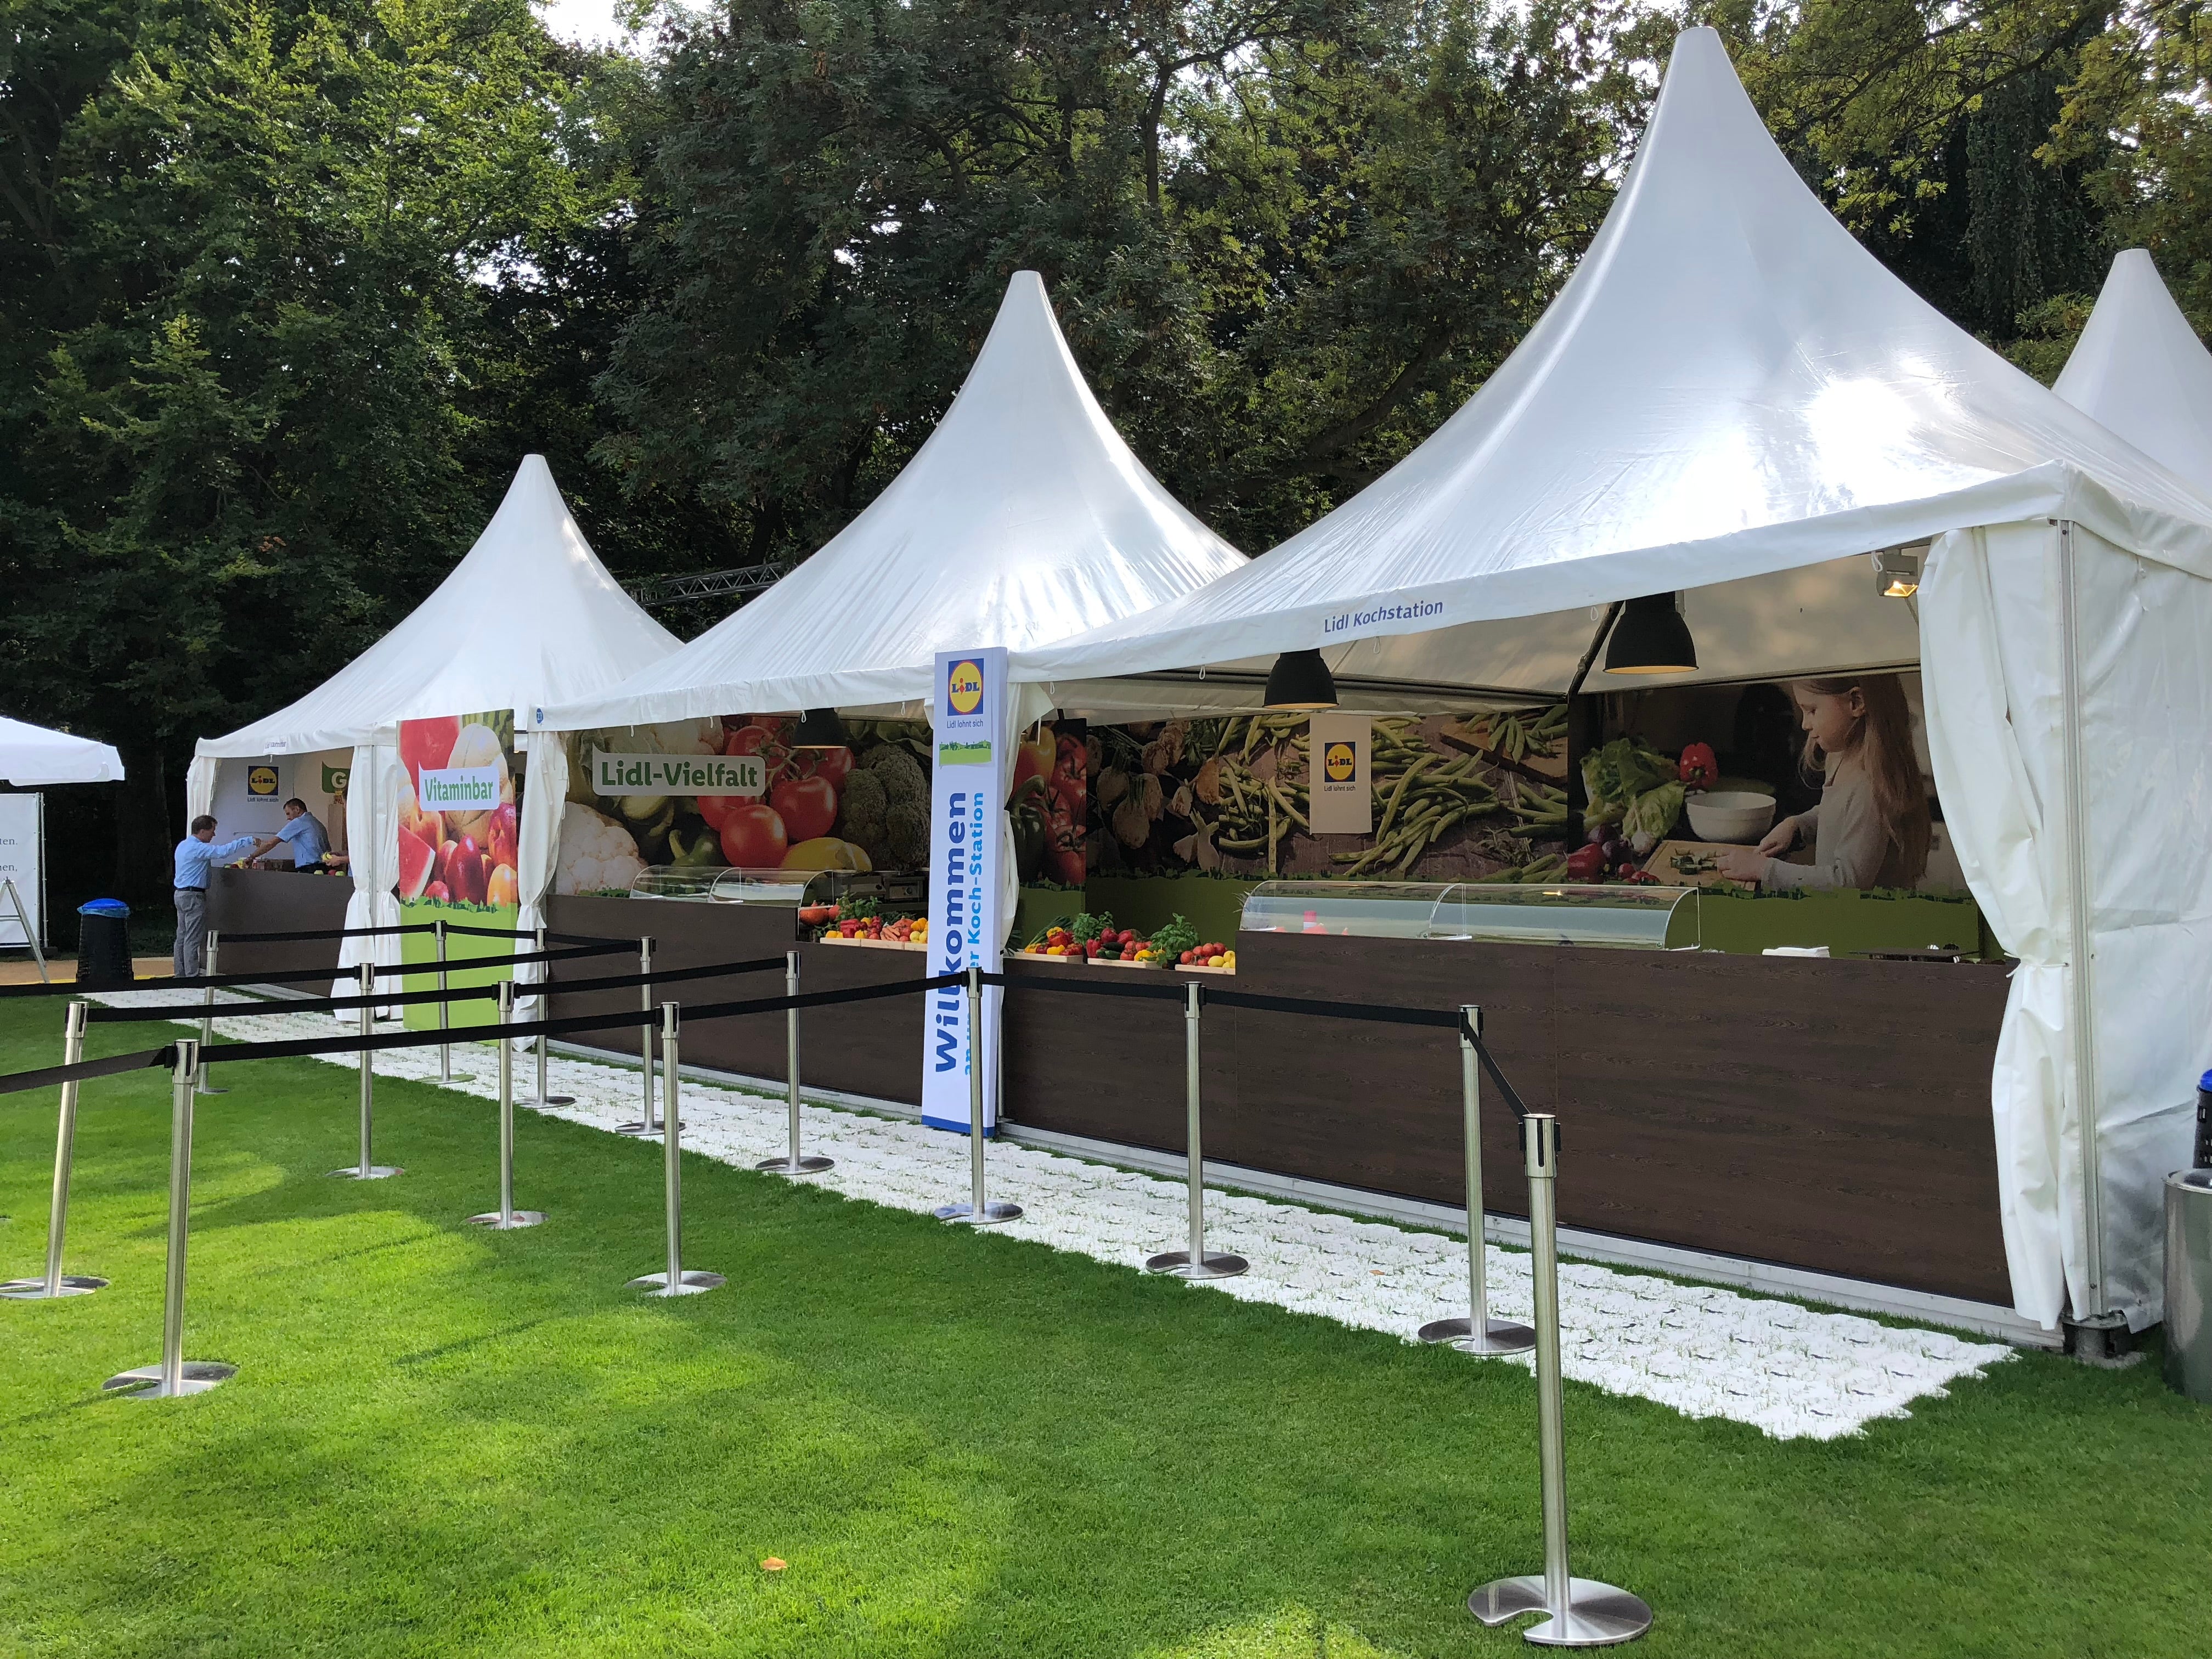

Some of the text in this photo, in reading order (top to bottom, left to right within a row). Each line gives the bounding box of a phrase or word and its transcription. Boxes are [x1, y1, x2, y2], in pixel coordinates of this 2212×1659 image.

[1324, 600, 1443, 633] Lidl Kochstation
[946, 718, 984, 729] Lidl lohnt sich
[425, 775, 493, 802] Vitaminbar
[602, 760, 758, 787] Lidl-Vielfalt
[967, 793, 984, 944] Koch-Station
[935, 793, 966, 1073] Willkommen
